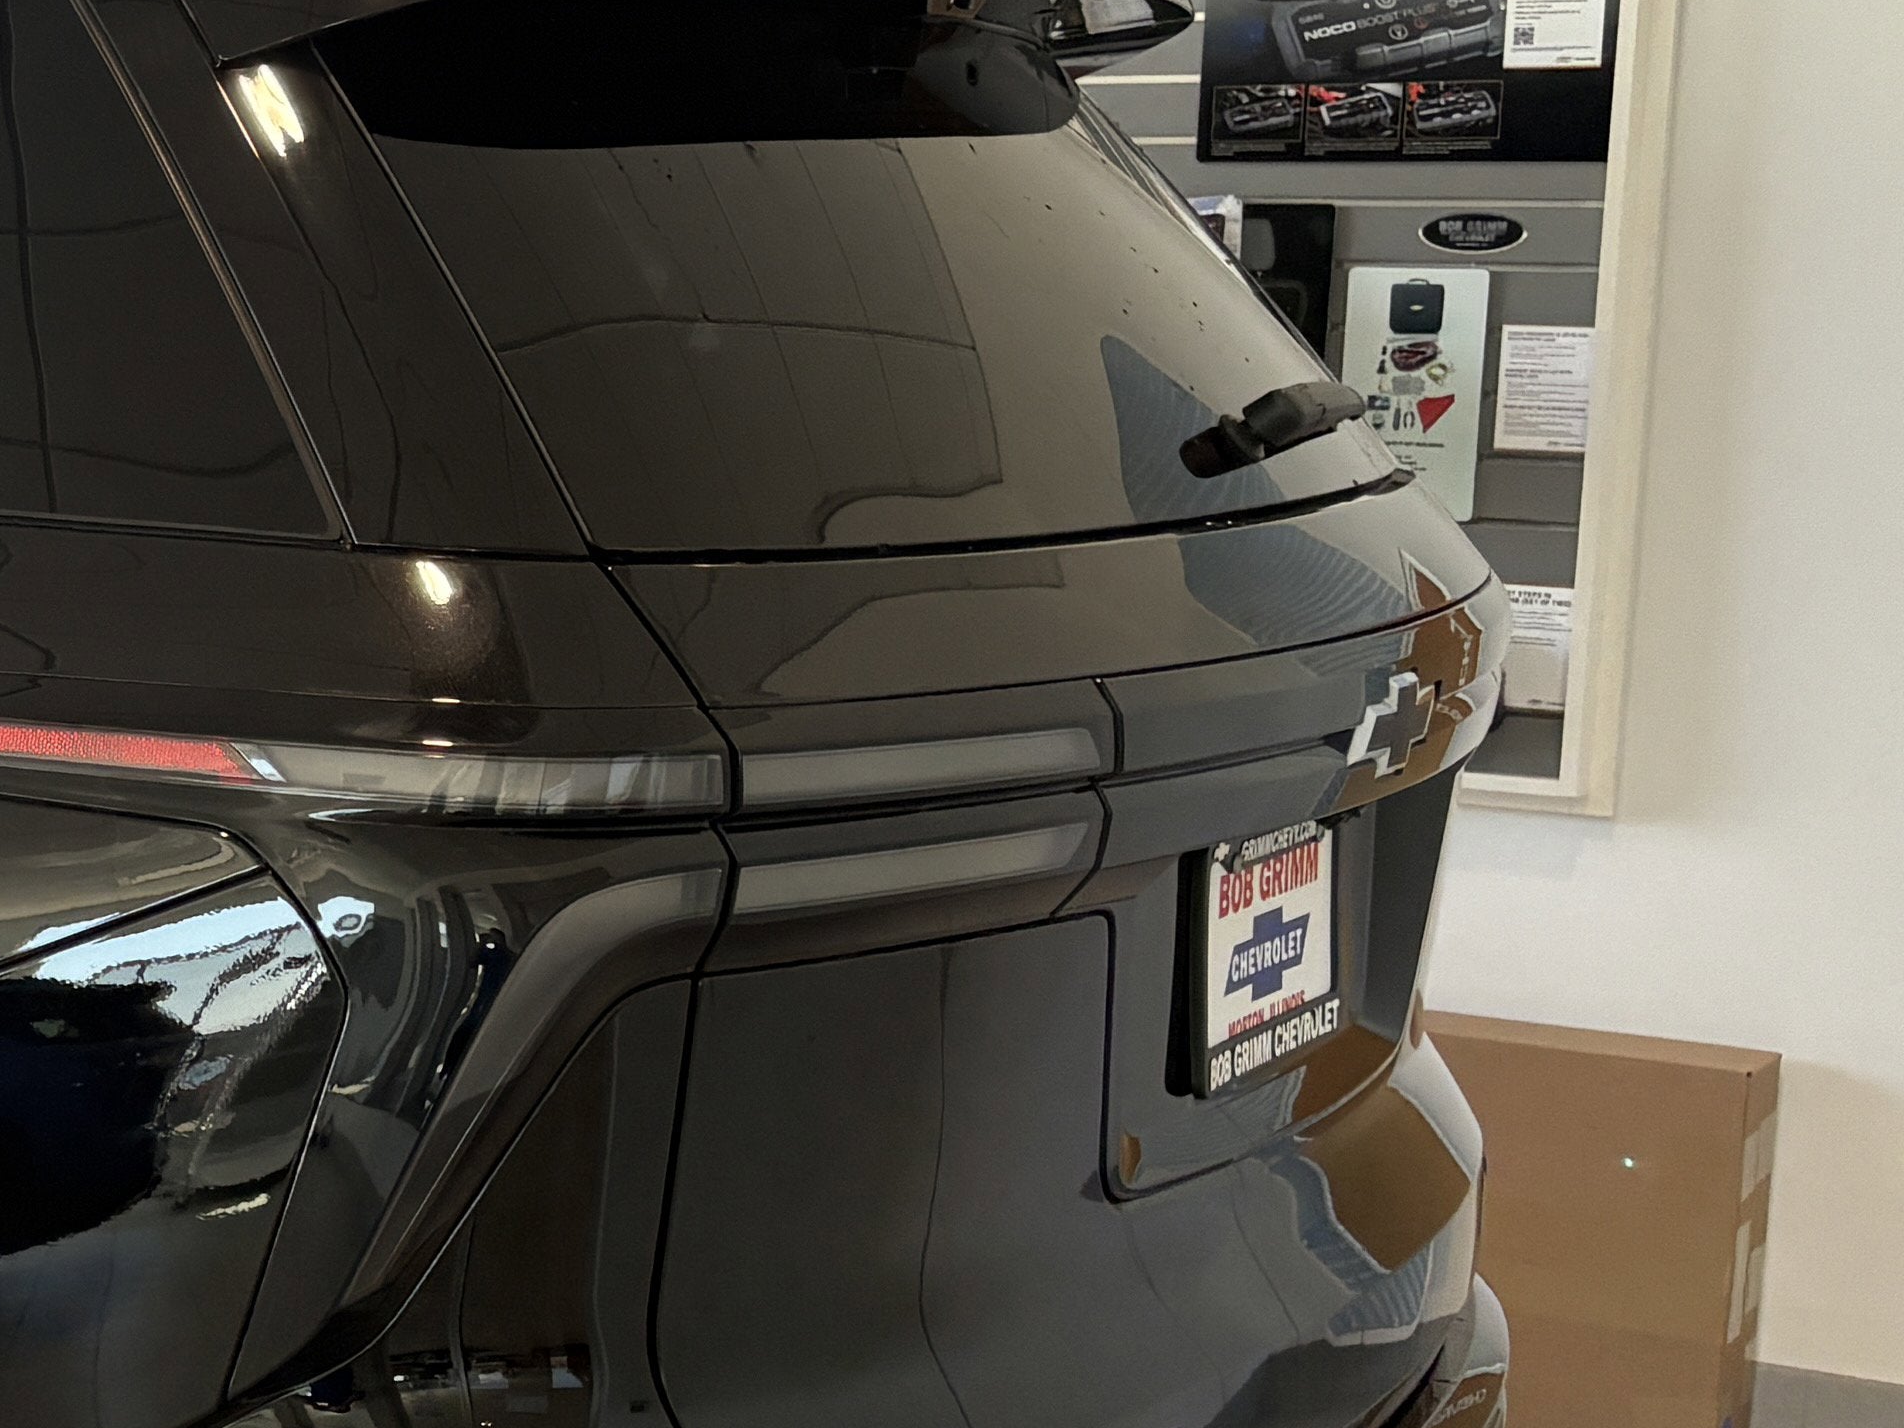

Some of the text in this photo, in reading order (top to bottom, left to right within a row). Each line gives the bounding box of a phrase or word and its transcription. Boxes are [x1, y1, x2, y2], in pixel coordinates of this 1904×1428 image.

[1303, 20, 1357, 43] NOCO
[1218, 842, 1320, 920] BOB GRIMM
[1231, 927, 1303, 983] CHEVROLET
[1210, 997, 1341, 1092] BOB GRIMM CHEVROLET
